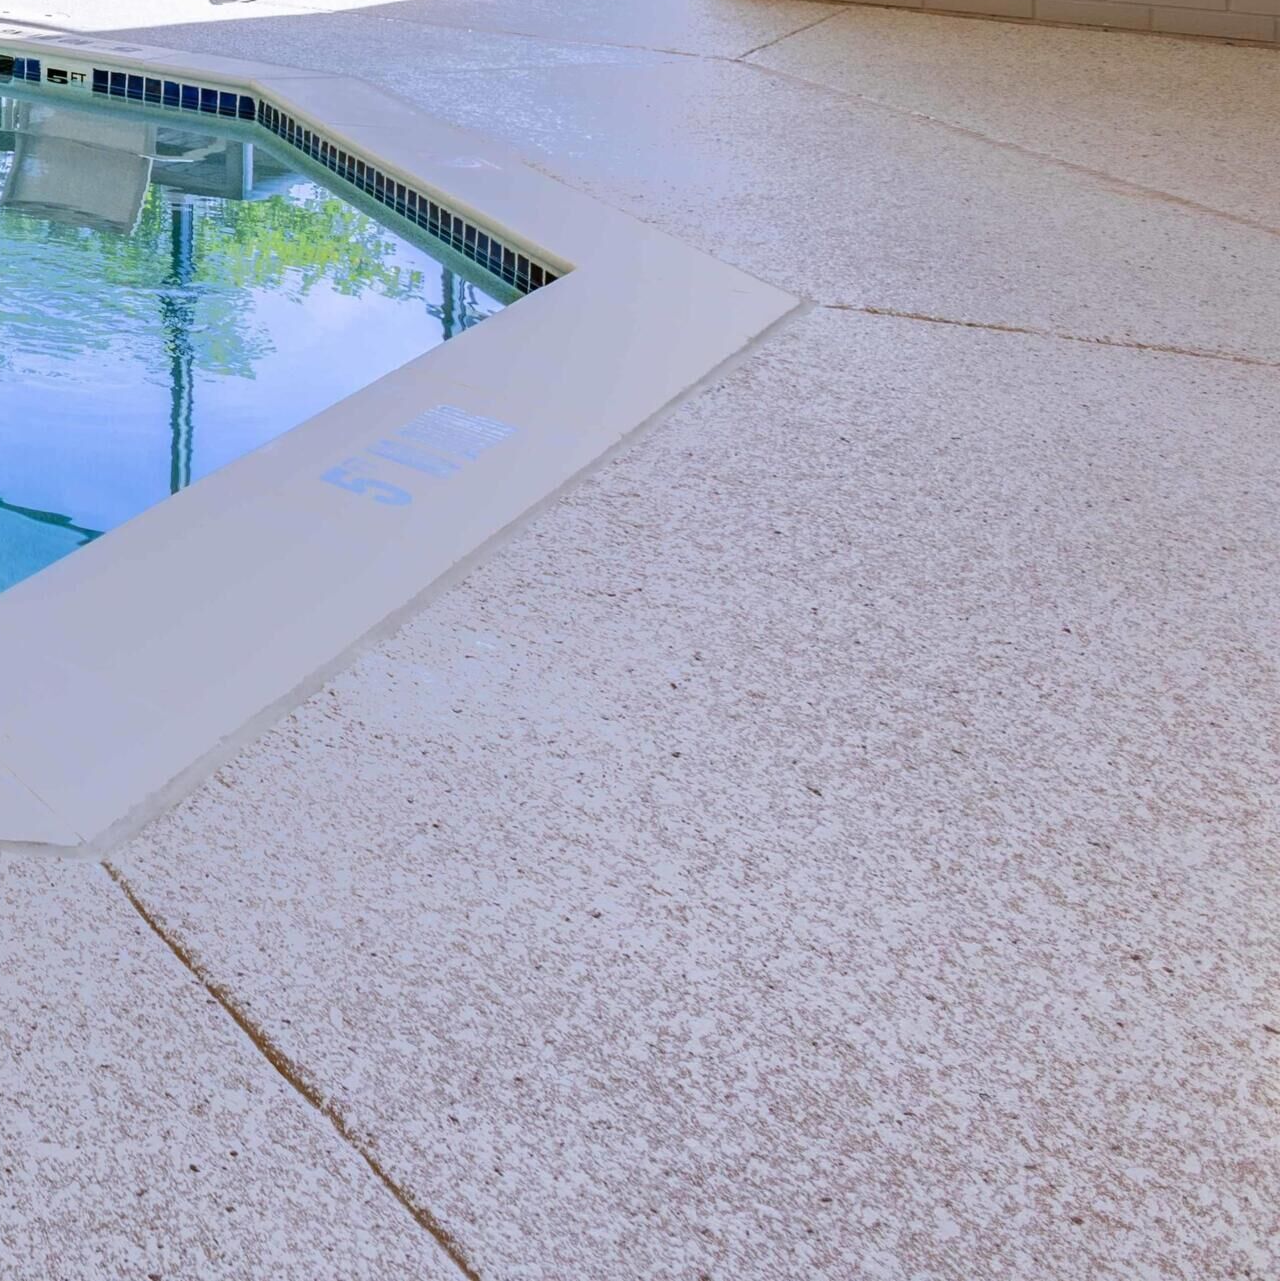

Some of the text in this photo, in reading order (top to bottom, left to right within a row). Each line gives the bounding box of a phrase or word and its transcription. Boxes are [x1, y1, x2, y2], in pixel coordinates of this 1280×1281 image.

[47, 67, 87, 84] 5 FT
[320, 465, 413, 507] 5
